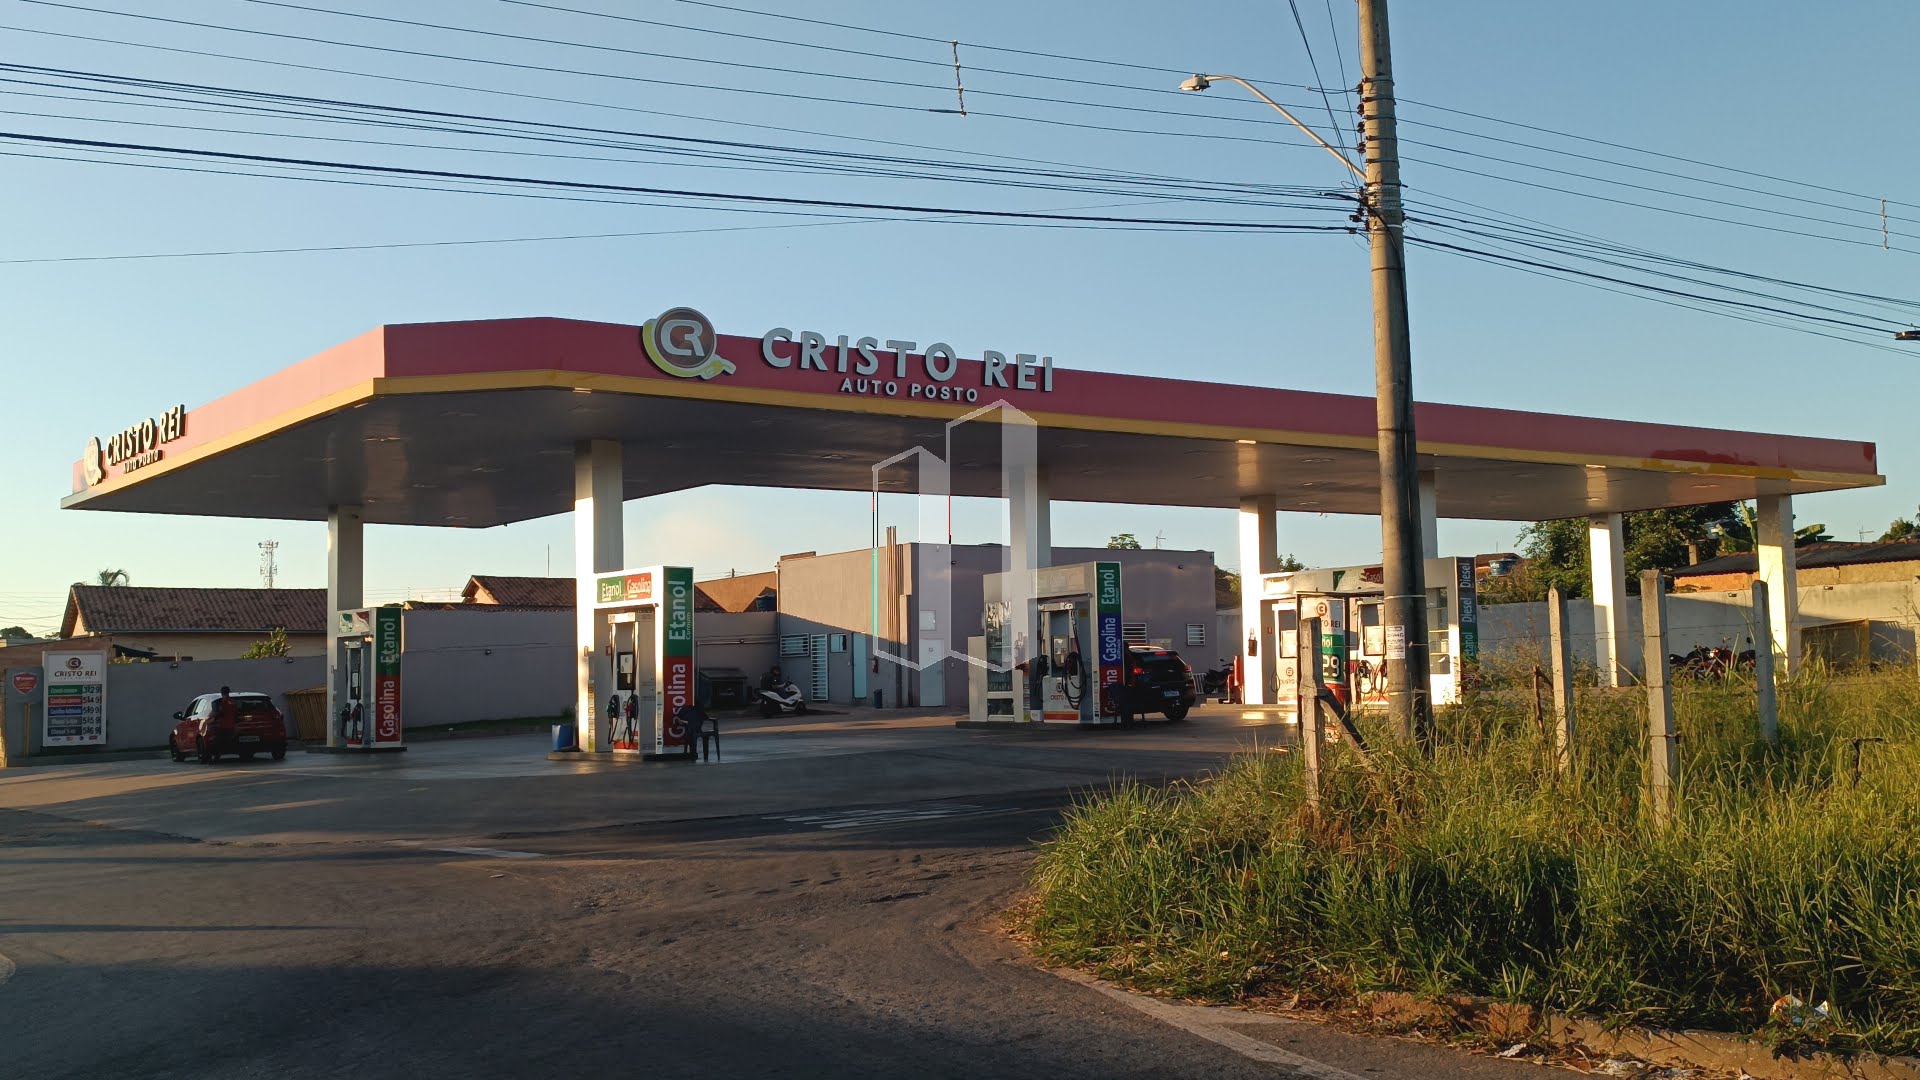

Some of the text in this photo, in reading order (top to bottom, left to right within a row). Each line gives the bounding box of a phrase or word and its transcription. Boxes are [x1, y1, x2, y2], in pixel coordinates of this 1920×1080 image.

[762, 327, 1053, 393] CRISTO REI
[841, 378, 978, 402] AUTO POSTO
[106, 404, 185, 467] CRISTO REI
[602, 581, 622, 597] Etanol
[1100, 569, 1116, 605] Etanol
[1459, 562, 1472, 588] Diesel
[668, 580, 686, 640] Etanol
[1460, 597, 1473, 623] Diesel
[380, 618, 396, 663] Etanol
[1101, 617, 1116, 662] Gasolina
[379, 680, 395, 737] Gasolina
